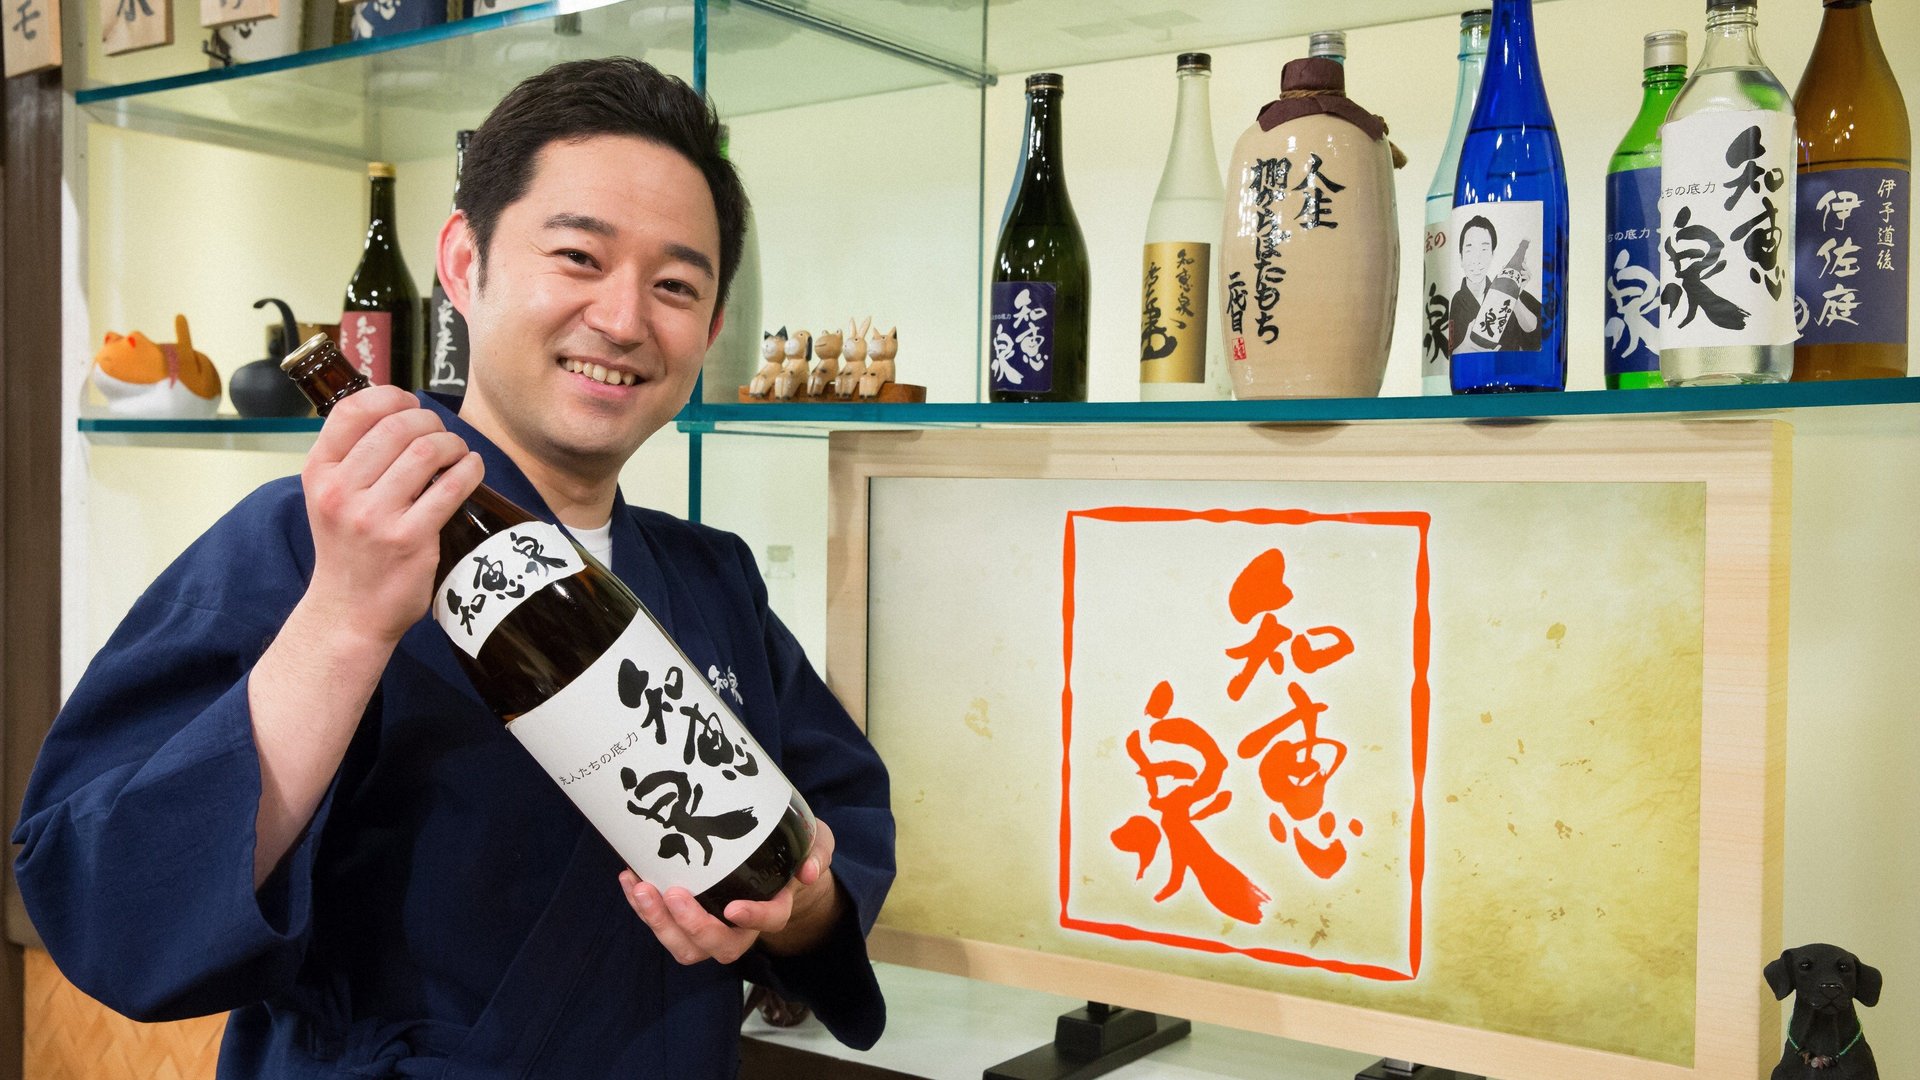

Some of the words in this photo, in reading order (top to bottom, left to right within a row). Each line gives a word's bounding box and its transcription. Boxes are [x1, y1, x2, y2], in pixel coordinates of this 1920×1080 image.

[1291, 153, 1346, 229] 人生
[1877, 178, 1897, 271] 伊予道後
[1175, 249, 1196, 318] 知恵泉
[1814, 190, 1864, 327] 伊佐庭
[1227, 272, 1248, 334] 二代目
[446, 531, 569, 636] 知恵泉
